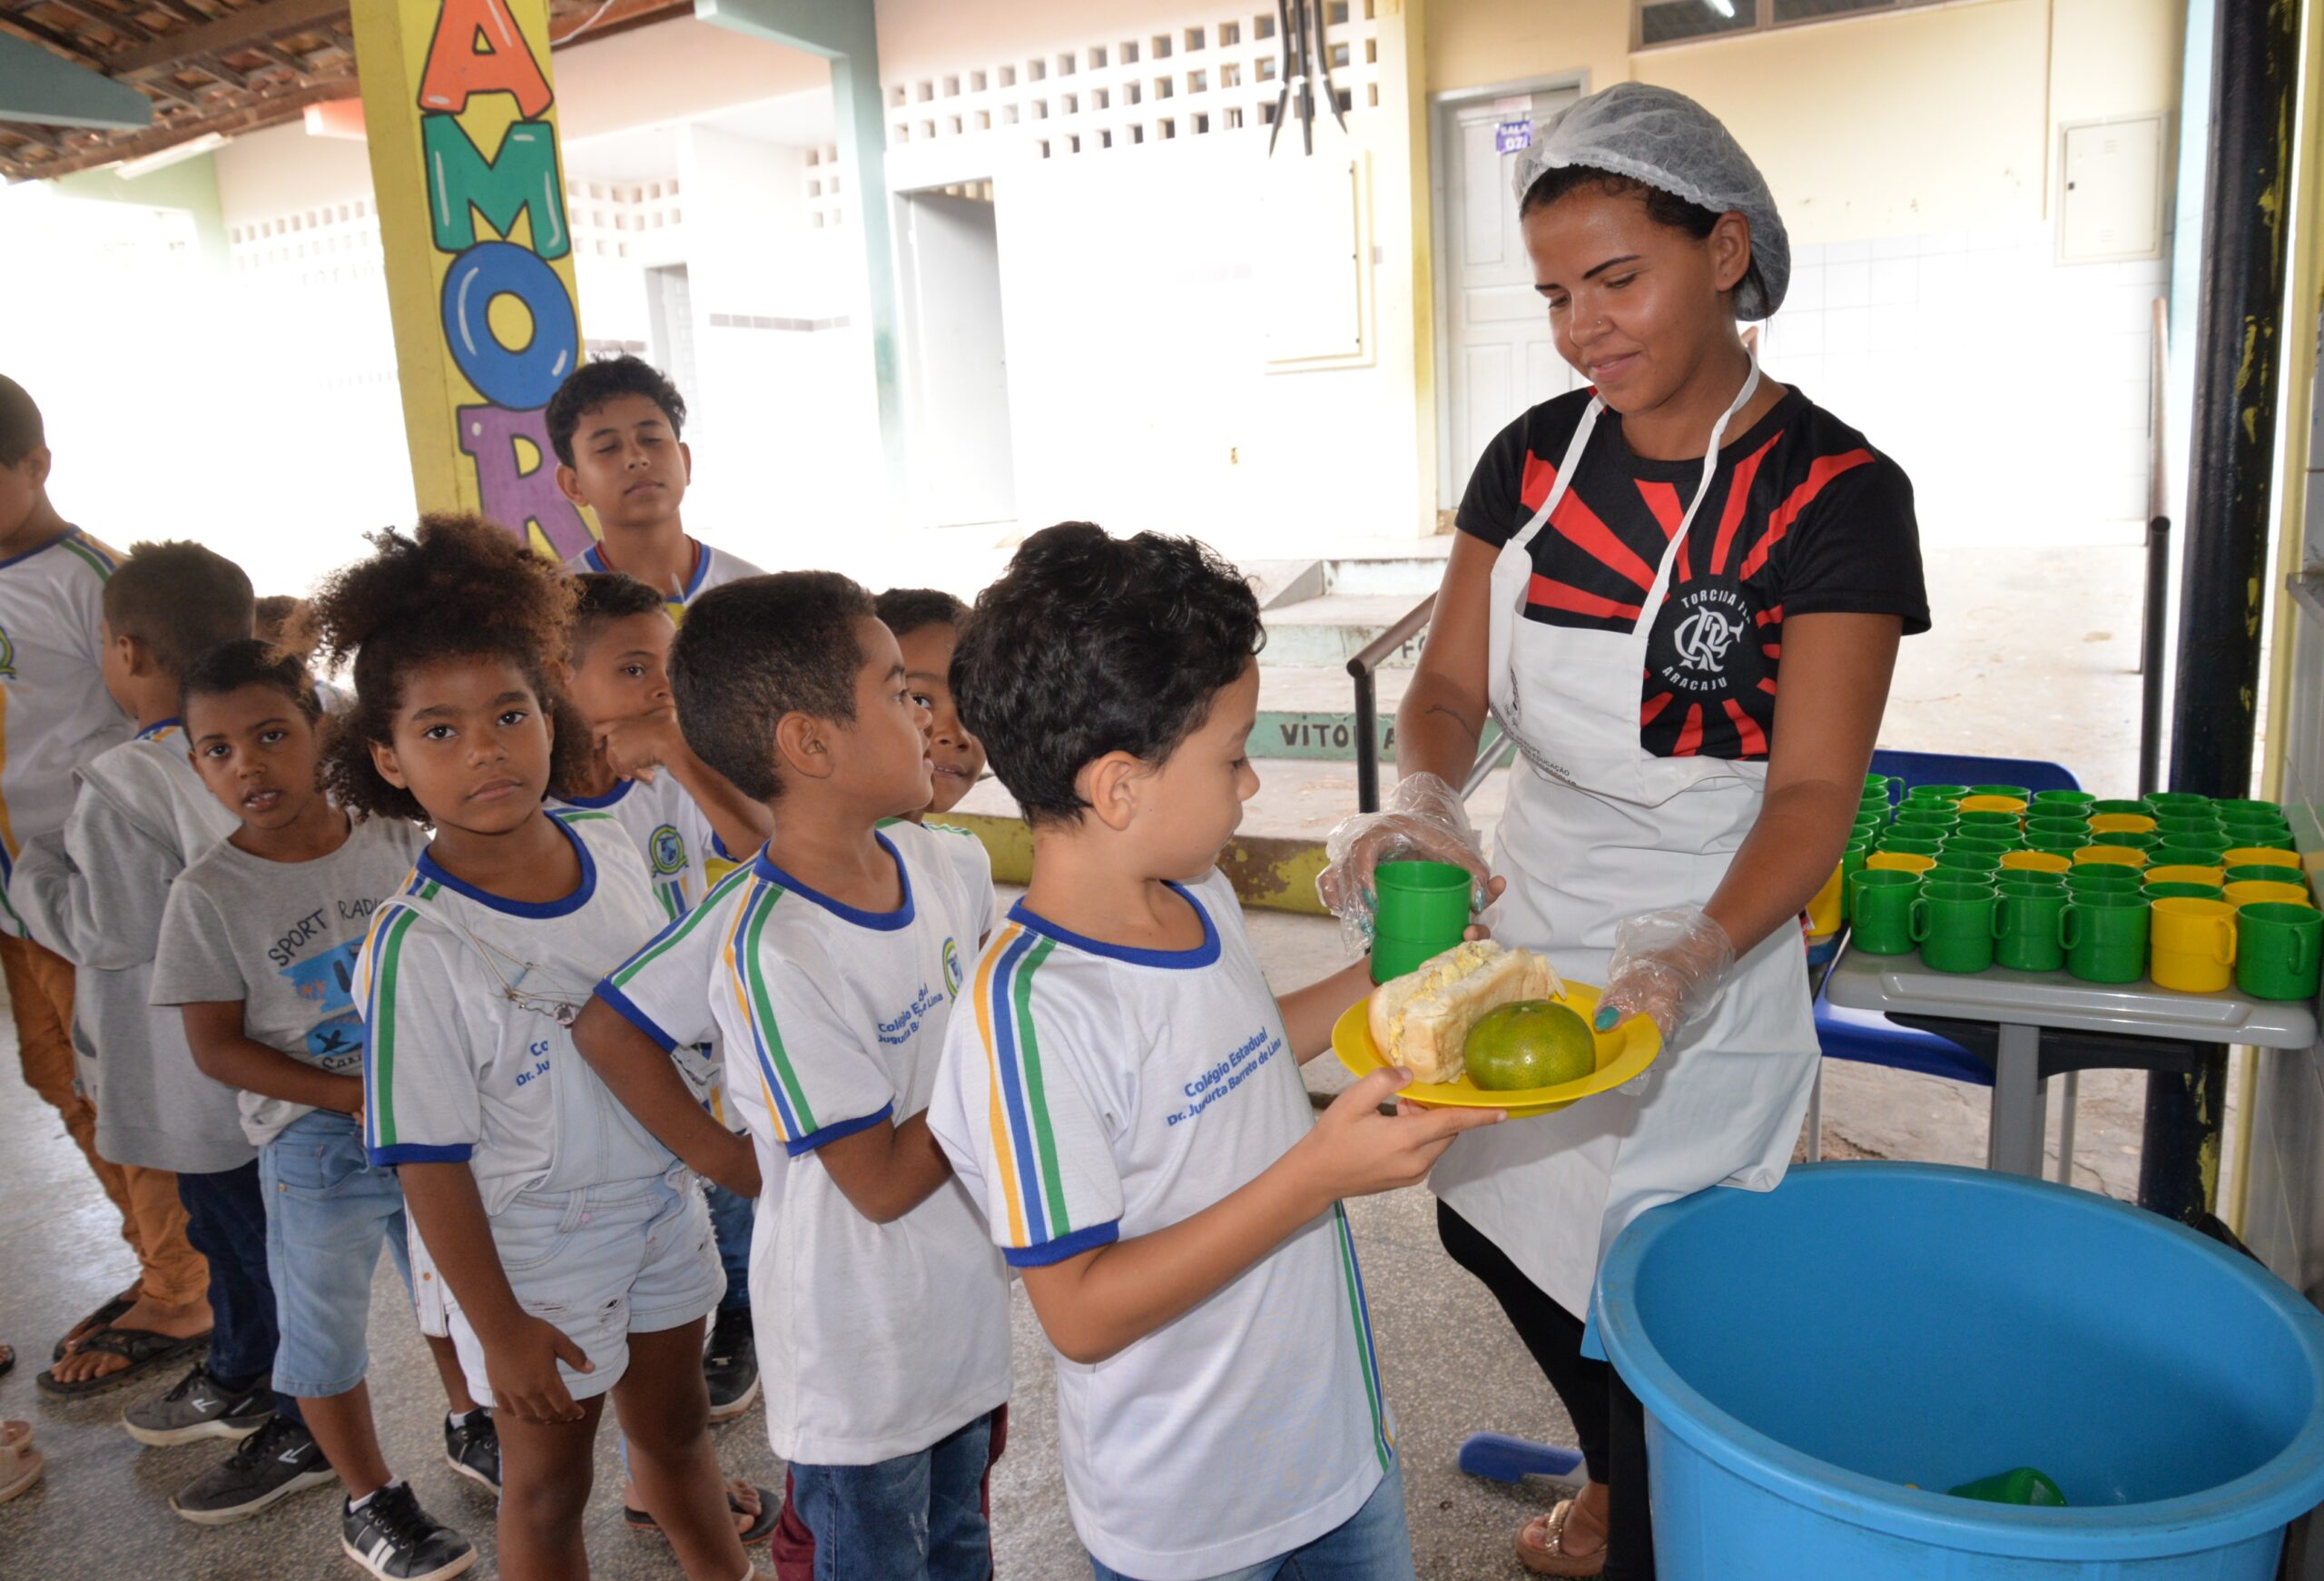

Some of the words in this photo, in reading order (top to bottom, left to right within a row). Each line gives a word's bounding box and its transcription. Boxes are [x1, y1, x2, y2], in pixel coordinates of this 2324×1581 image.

[417, 0, 596, 571] AMOR
[1662, 666, 1728, 691] ARACAJU
[268, 909, 328, 967] SPORT
[338, 898, 384, 922] RADI
[516, 1072, 536, 1087] Dr.
[1167, 1112, 1187, 1127] Dr.
[1227, 1060, 1258, 1091] Barreto
[1258, 1052, 1269, 1065] de
[1184, 1062, 1231, 1098] Colégio
[1228, 1025, 1268, 1068] Estadual
